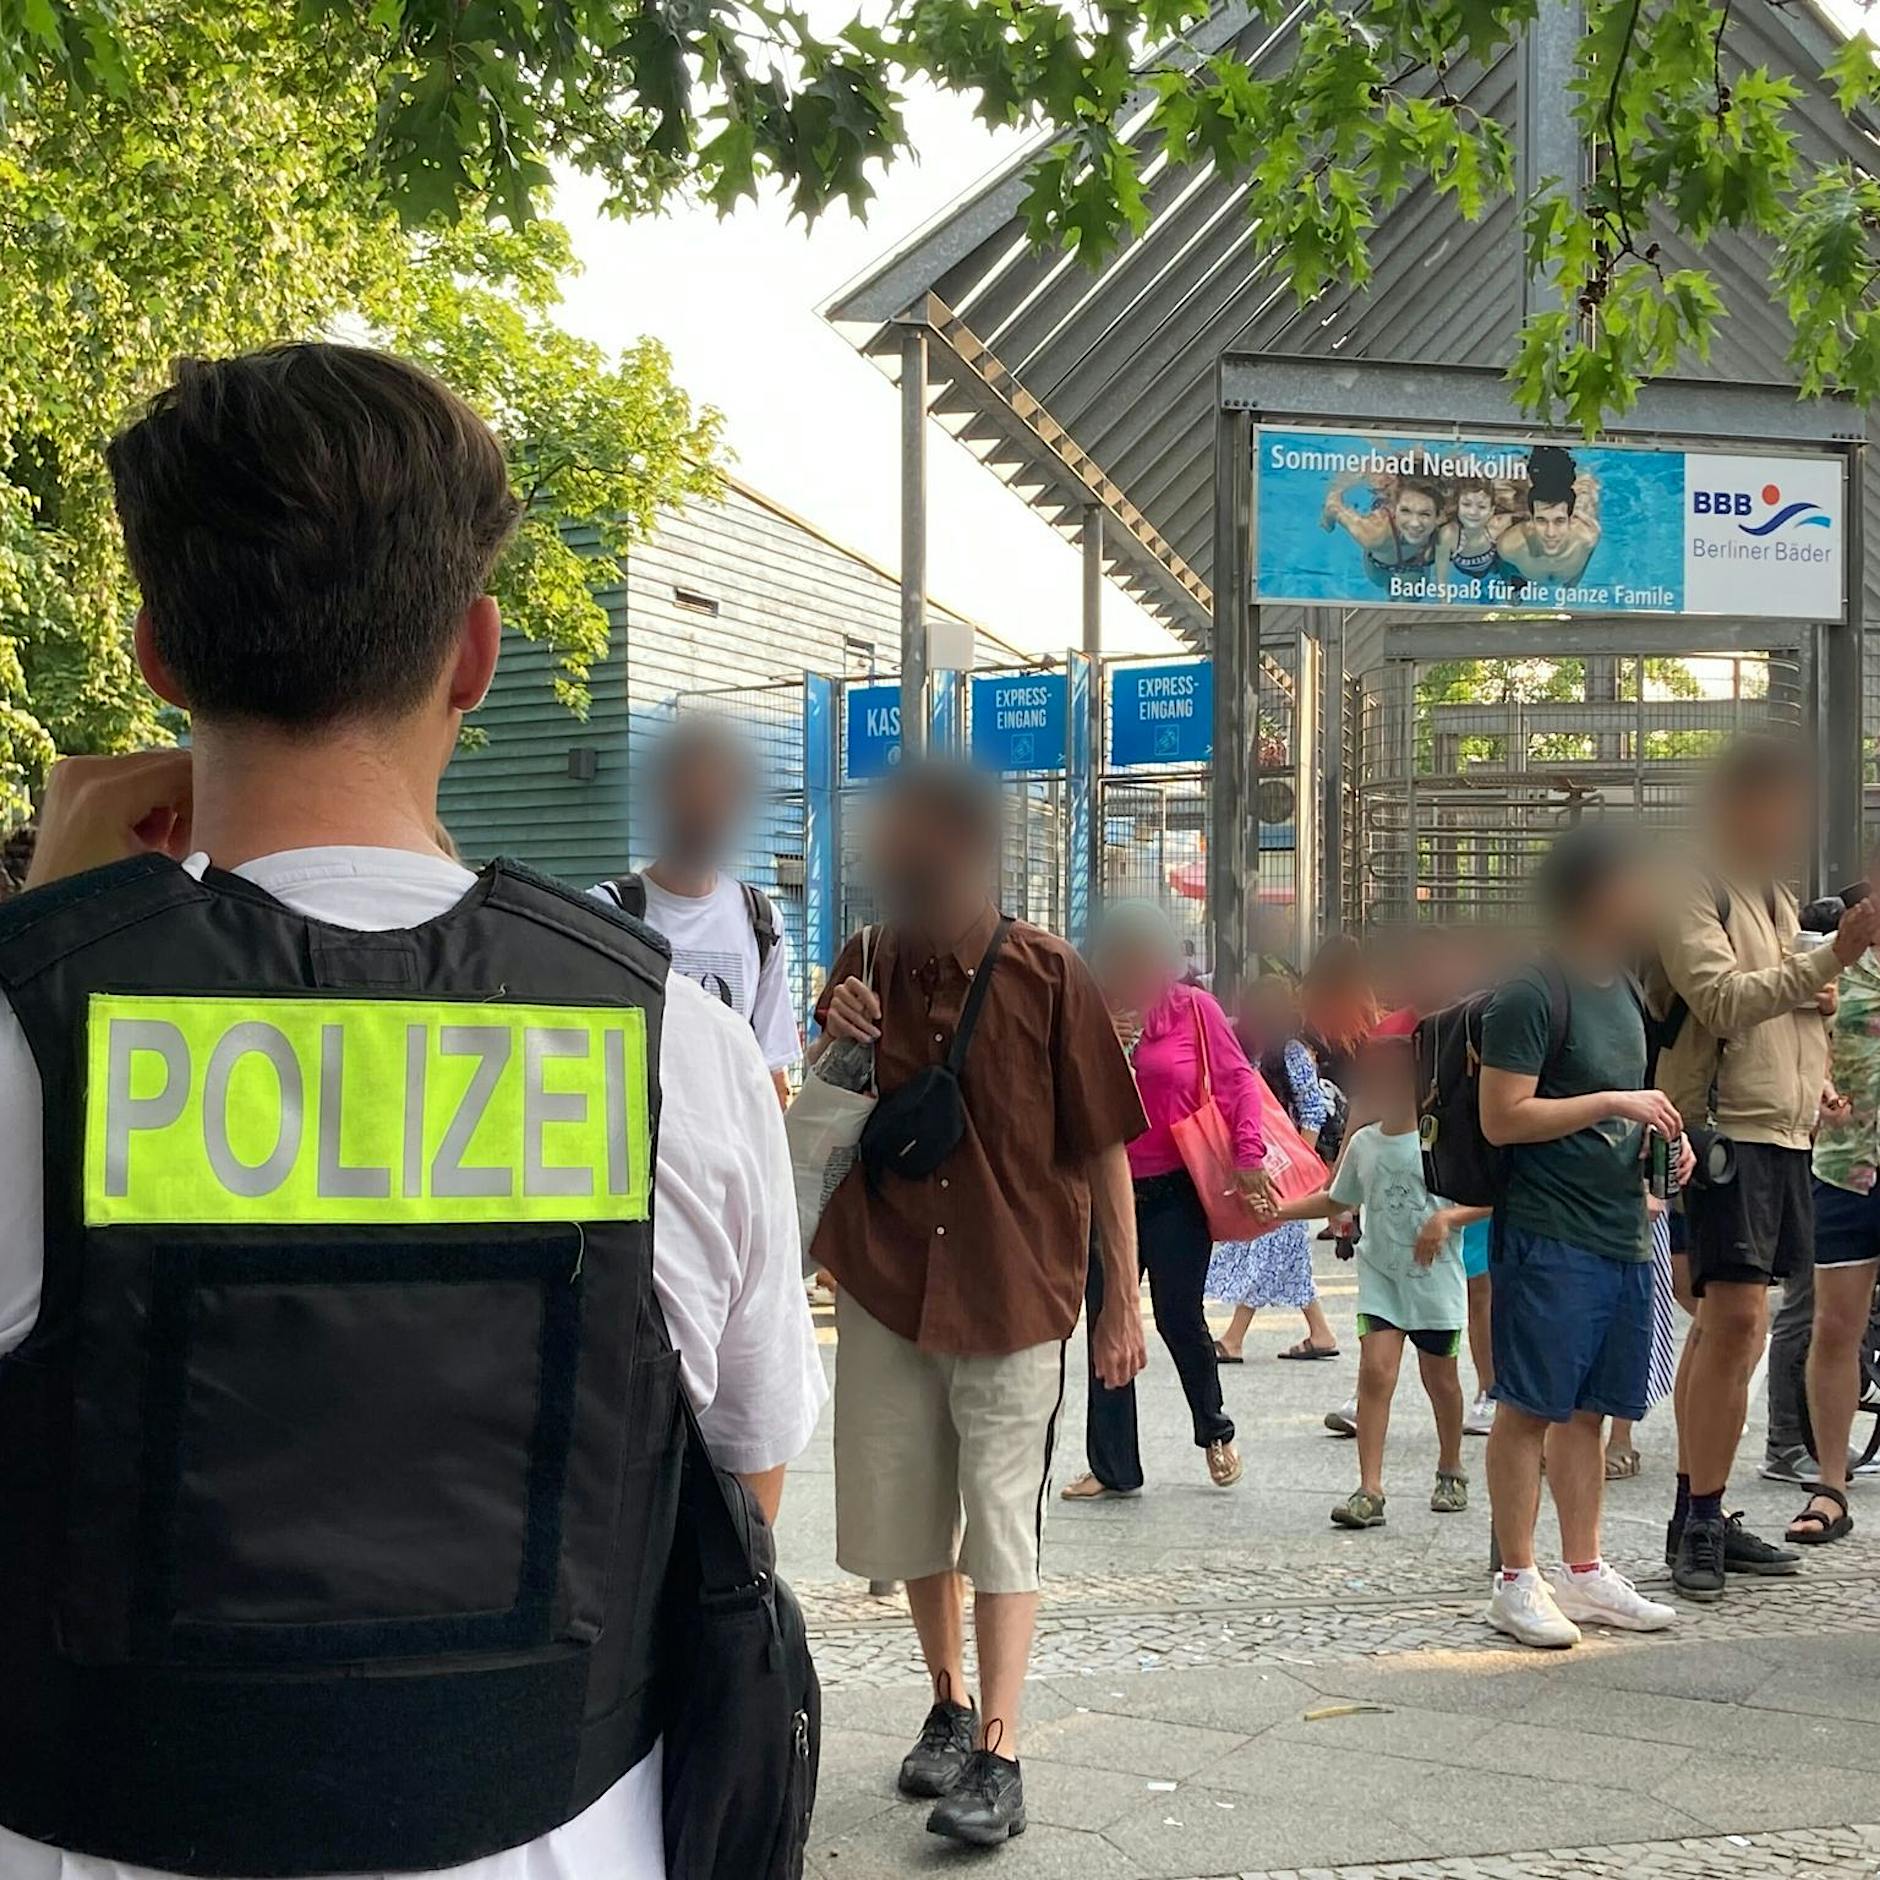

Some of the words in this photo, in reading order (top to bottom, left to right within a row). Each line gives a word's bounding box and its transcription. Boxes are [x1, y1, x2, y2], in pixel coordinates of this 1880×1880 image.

[1271, 445, 1415, 476] Sommerbad
[1423, 451, 1528, 480] Neukölln
[1693, 491, 1752, 516] BBB
[1693, 538, 1770, 560] Berliner
[1775, 541, 1832, 562] Bäder
[1390, 577, 1481, 603] Badespaß
[1487, 579, 1516, 600] für
[1520, 581, 1549, 601] die
[1555, 586, 1609, 606] ganze
[1615, 585, 1674, 606] Famile
[996, 686, 1052, 708] EXPRESS-
[1138, 675, 1199, 698] EXPRESS-
[867, 706, 901, 737] KAS
[997, 709, 1047, 730] EINGANG
[1139, 699, 1193, 720] EINGANG
[104, 1018, 630, 1199] POLIZEI
